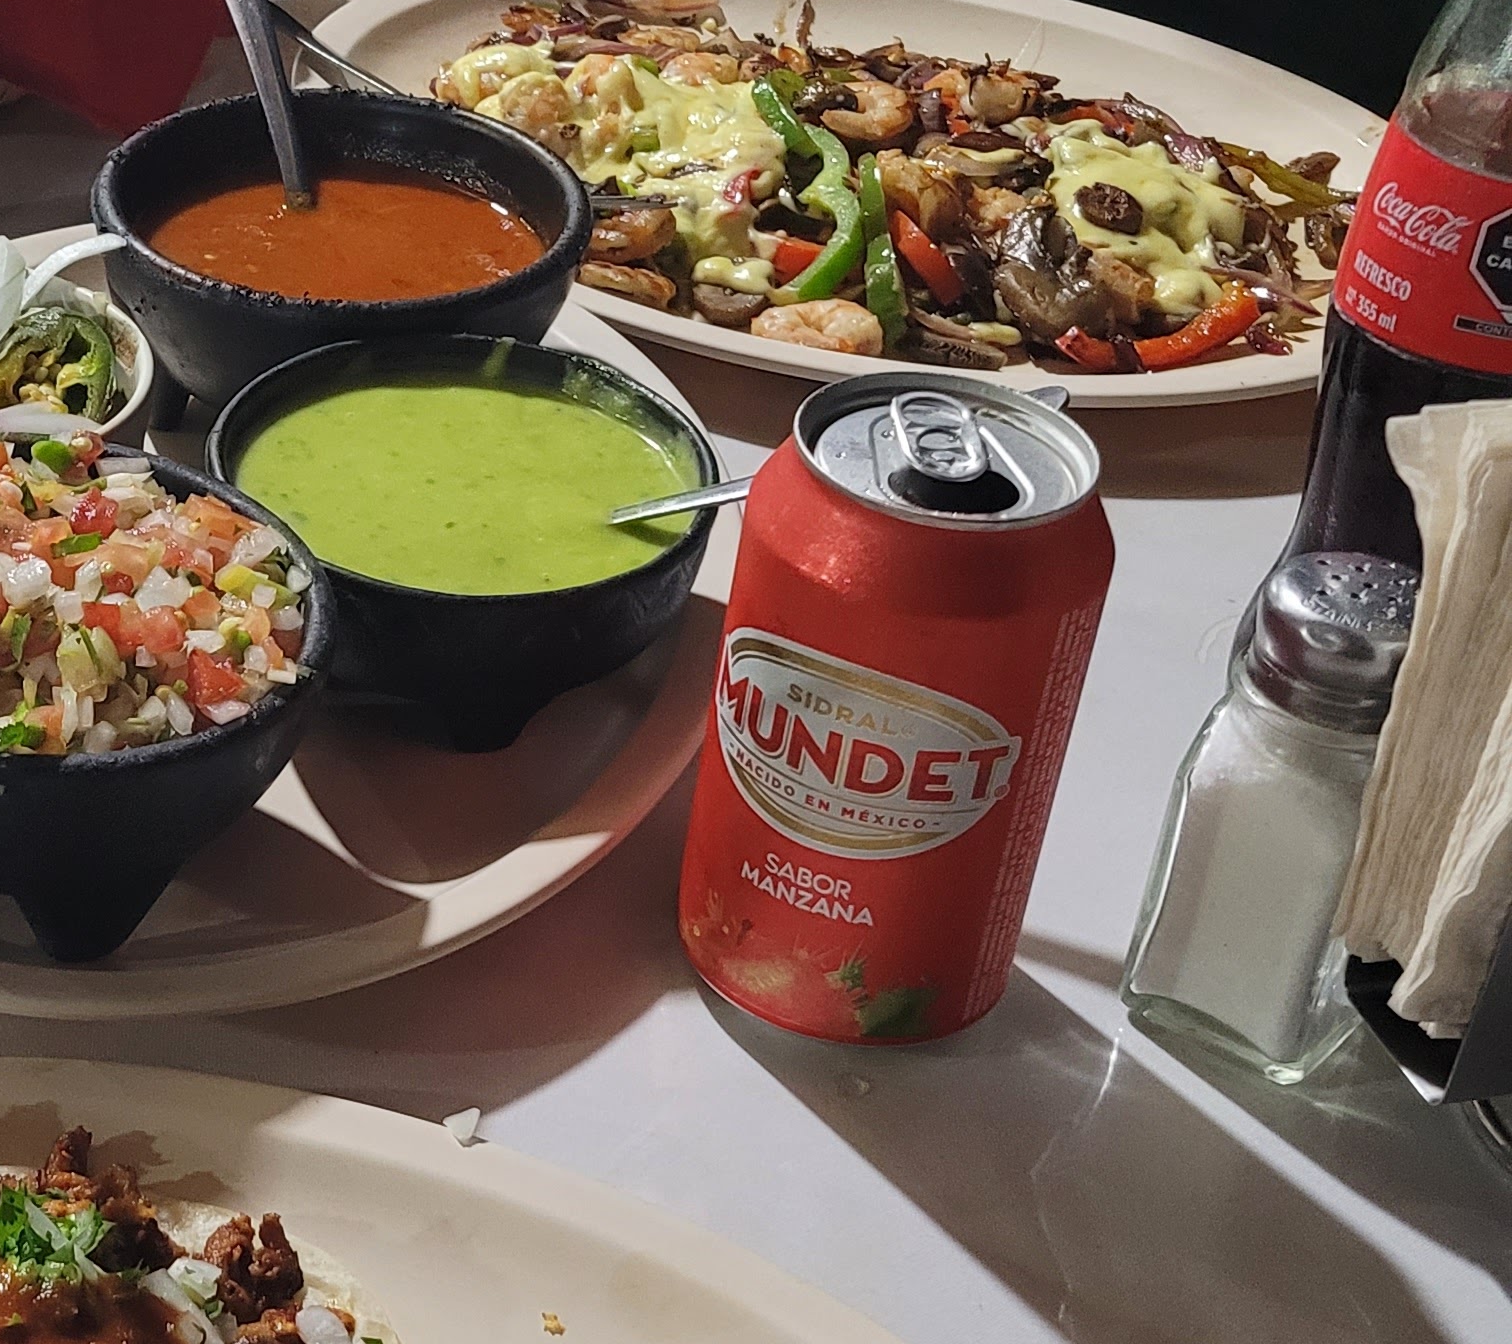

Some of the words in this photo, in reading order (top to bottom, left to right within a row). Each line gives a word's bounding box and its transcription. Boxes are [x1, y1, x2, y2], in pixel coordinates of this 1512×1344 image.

[1373, 181, 1474, 252] Coca-Cola
[1354, 249, 1412, 302] REFRESCO
[1356, 294, 1379, 322] 355
[1378, 313, 1397, 333] ml
[719, 651, 1011, 804] MUNDET
[786, 683, 896, 737] SIDRAL
[736, 748, 796, 797] NACIDO
[804, 793, 831, 812] EN
[840, 804, 927, 830] MÉXICO
[741, 860, 874, 927] MANZANA
[764, 852, 852, 900] SABOR
